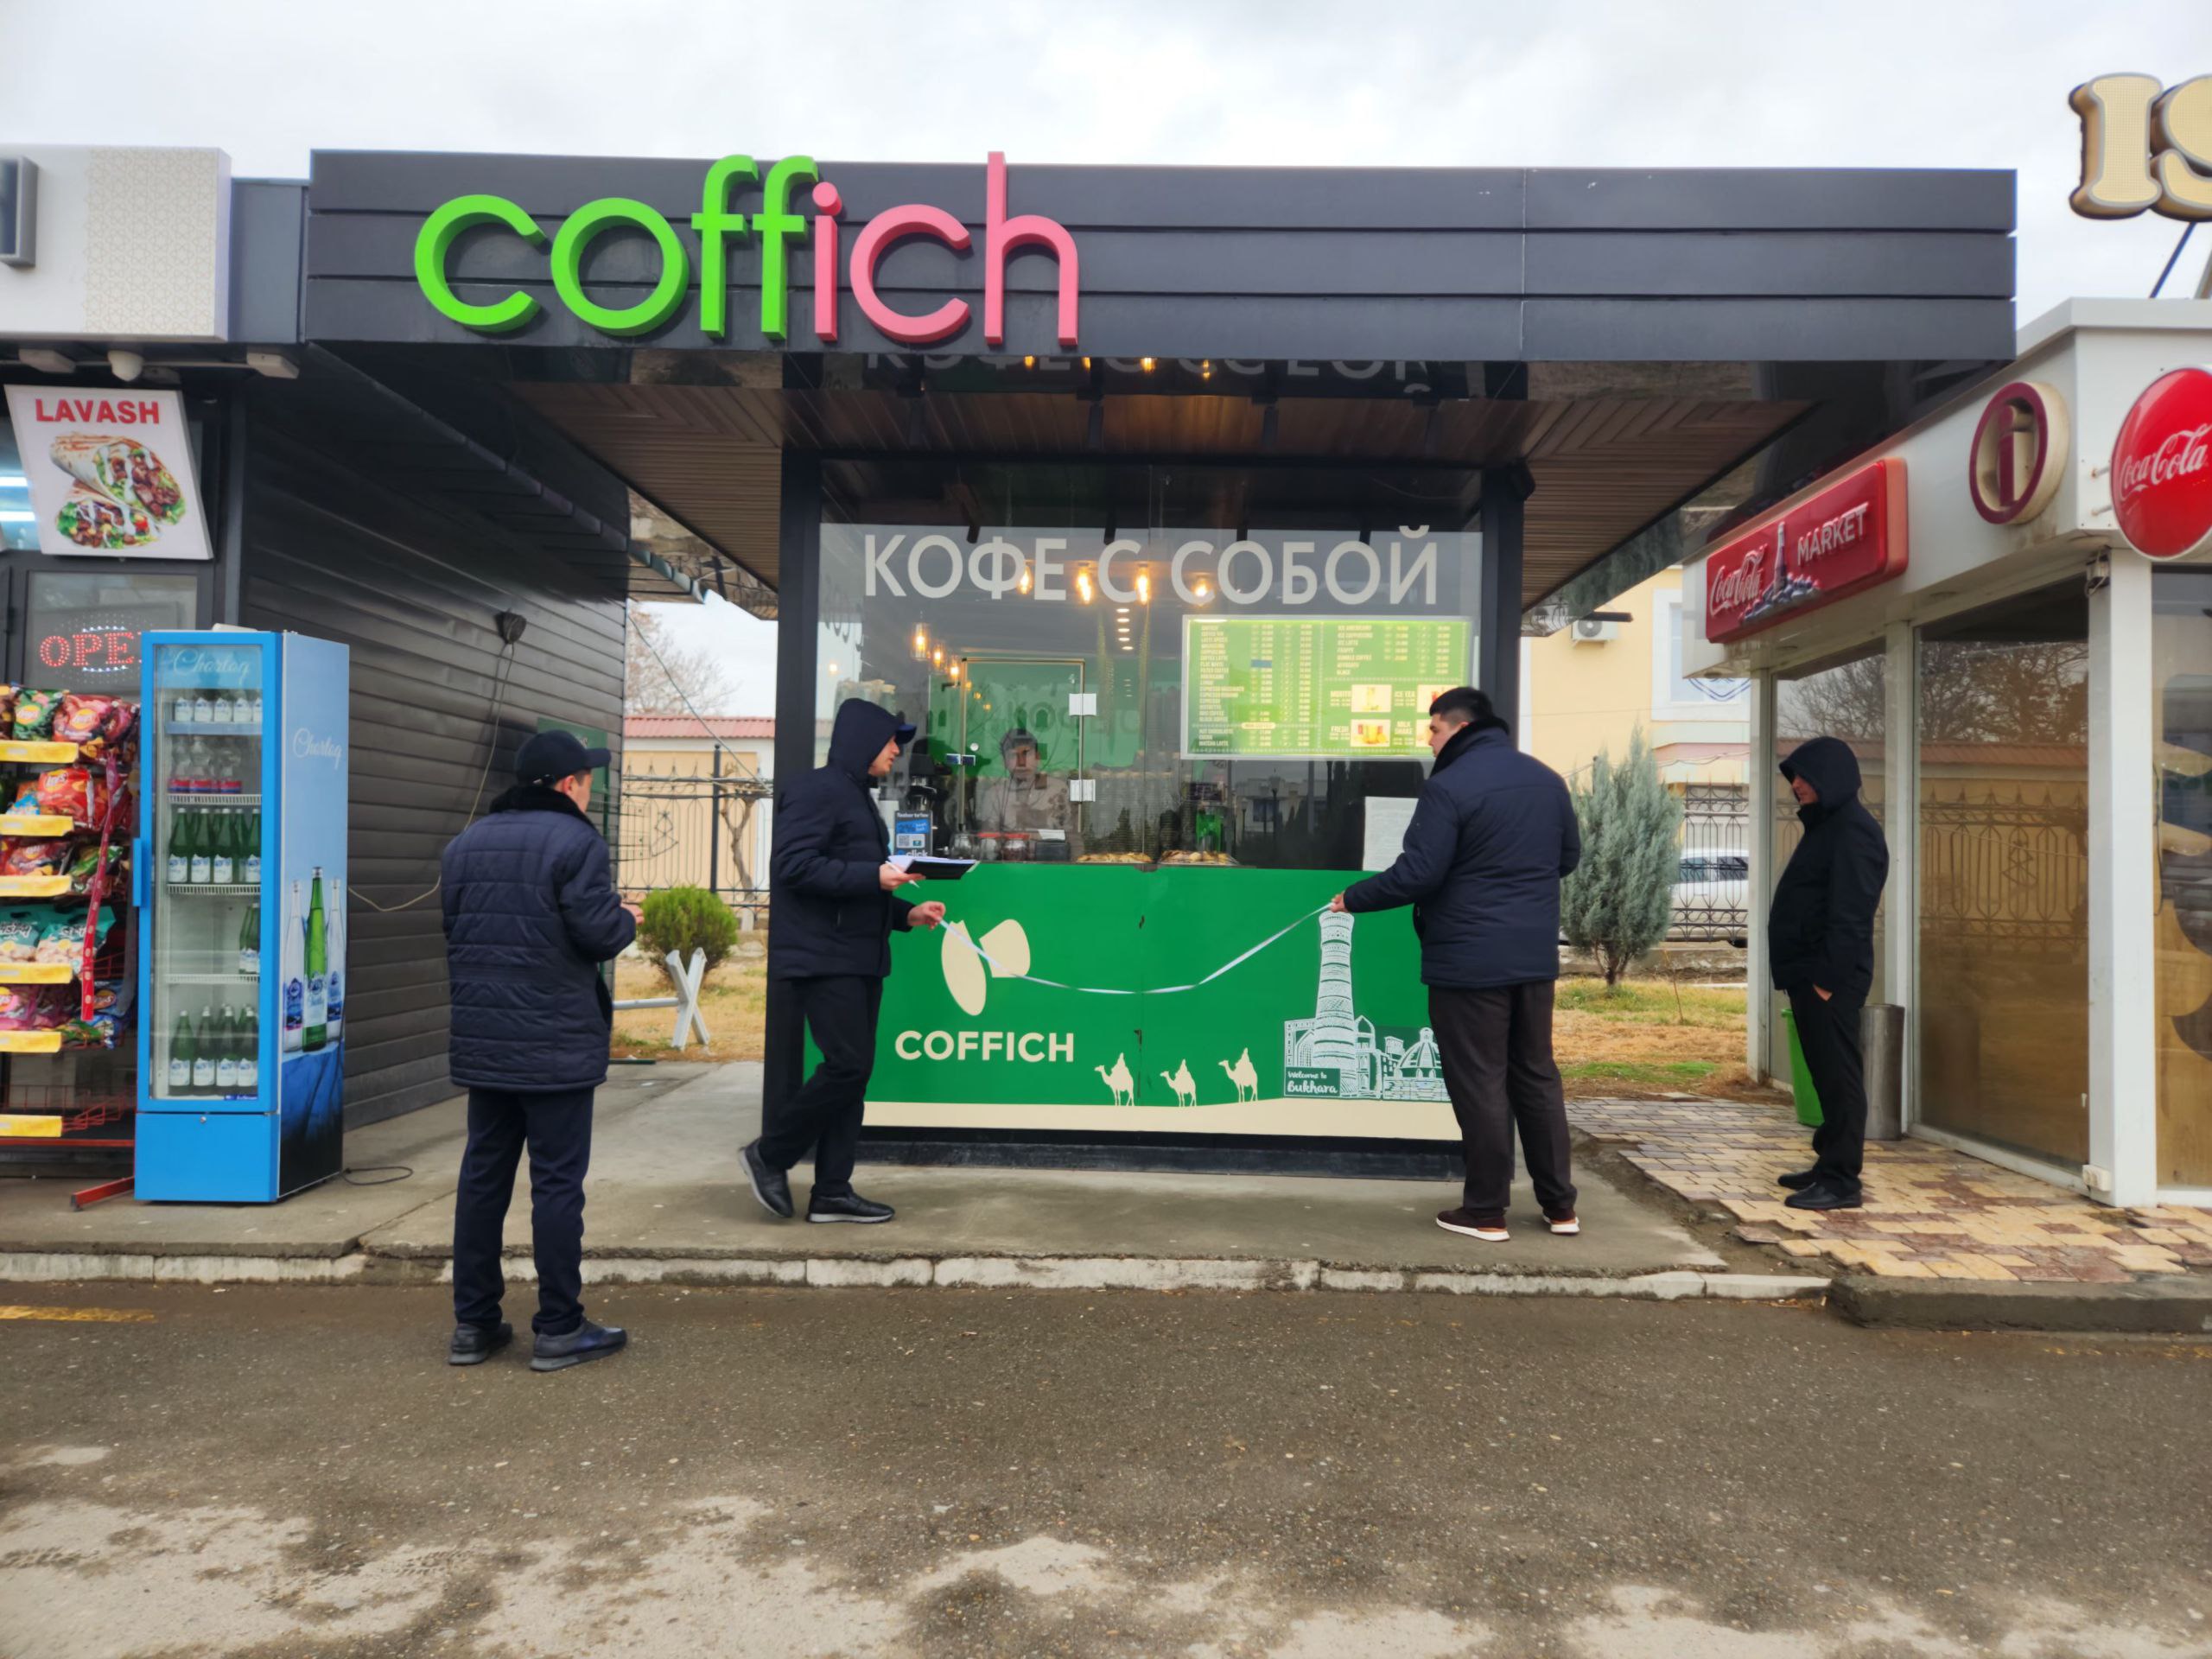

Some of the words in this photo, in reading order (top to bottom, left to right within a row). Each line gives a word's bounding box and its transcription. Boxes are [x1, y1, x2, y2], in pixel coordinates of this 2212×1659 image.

[415, 151, 1077, 345] coffich
[35, 398, 159, 424] LAVASH
[1798, 501, 1869, 566] MARKET
[865, 535, 1067, 601] КОФЕ
[1097, 539, 1143, 603] С
[1171, 525, 1437, 604] СОБОЙ
[40, 632, 142, 667] OPE
[895, 1030, 1074, 1063] COFFICH
[1287, 1070, 1319, 1079] Welcome
